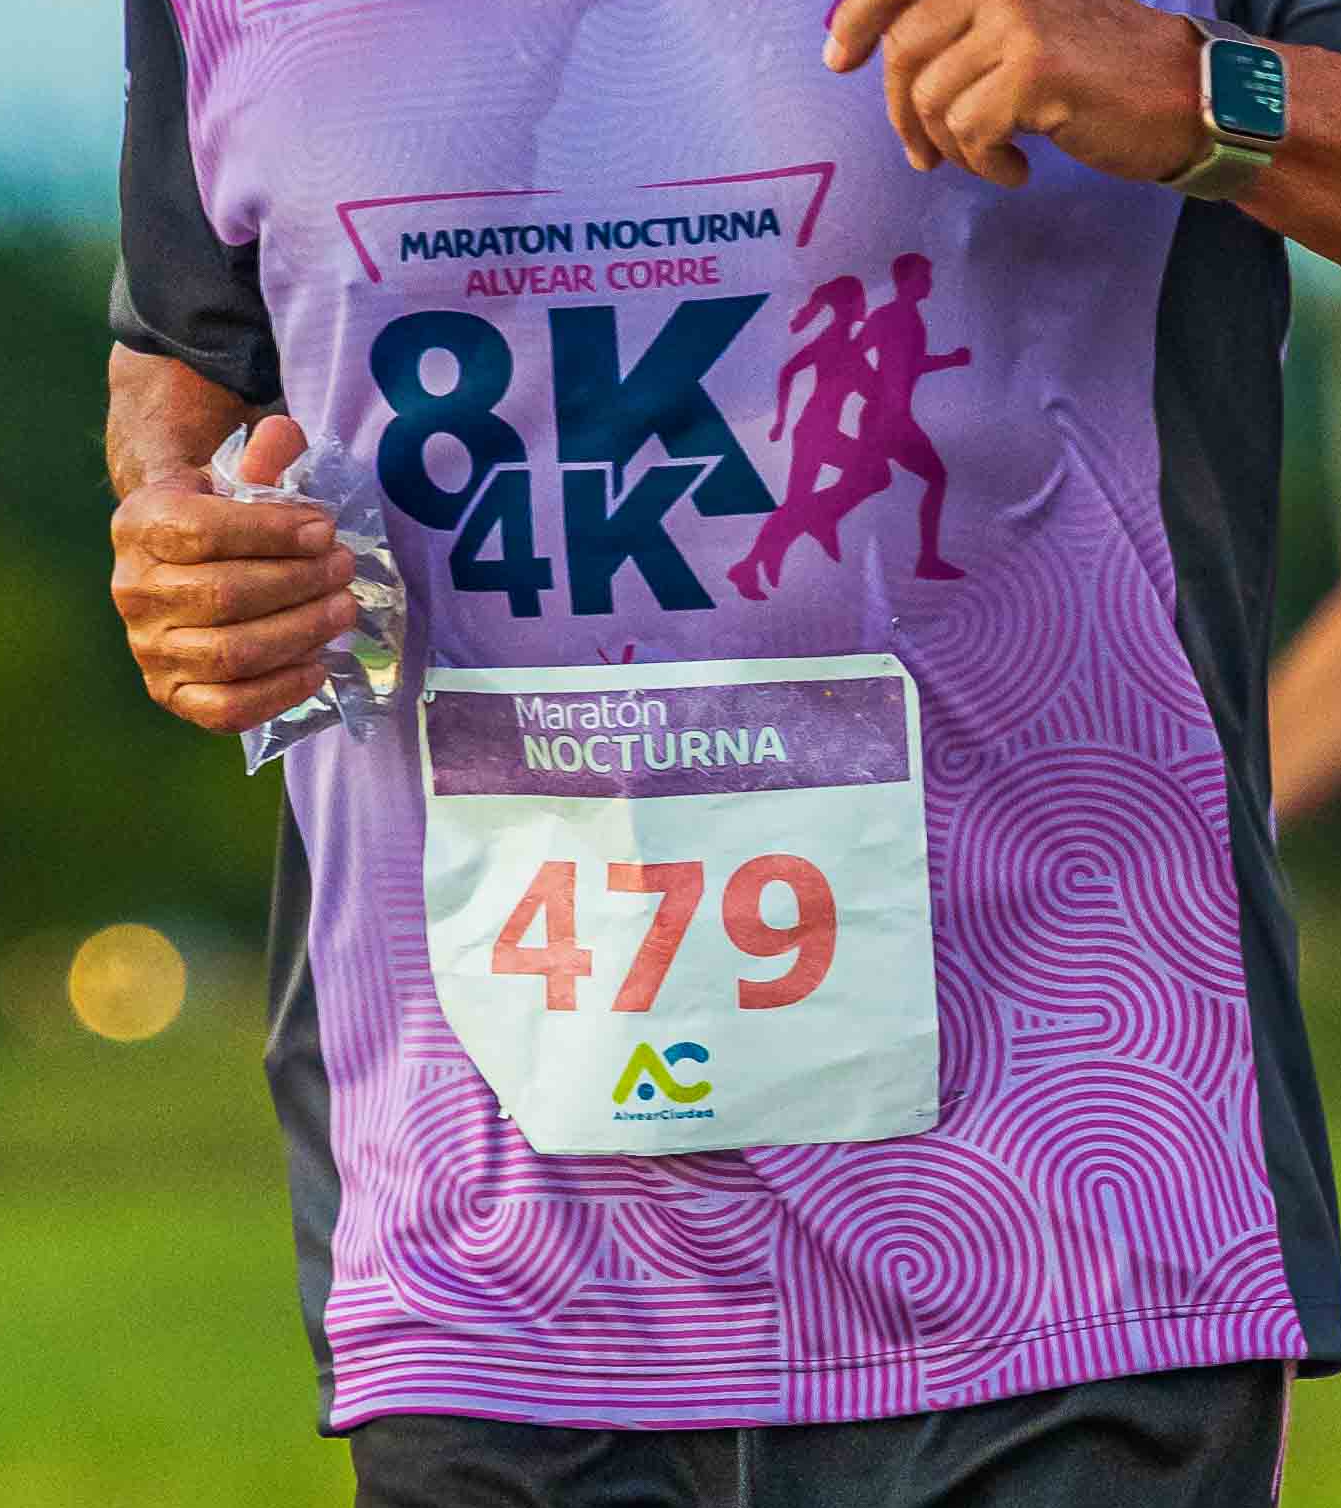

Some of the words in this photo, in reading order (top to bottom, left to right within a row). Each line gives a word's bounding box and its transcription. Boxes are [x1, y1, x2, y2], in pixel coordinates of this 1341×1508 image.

[400, 221, 574, 263] MARATON
[586, 207, 781, 251] NOCTURNA
[465, 264, 597, 297] ALVEAR
[606, 255, 722, 291] CORRE
[369, 292, 779, 531] 8K
[449, 464, 717, 618] 4K
[514, 689, 668, 730] Maratón
[522, 726, 788, 774] NOCTURNA
[491, 853, 838, 1013] 479
